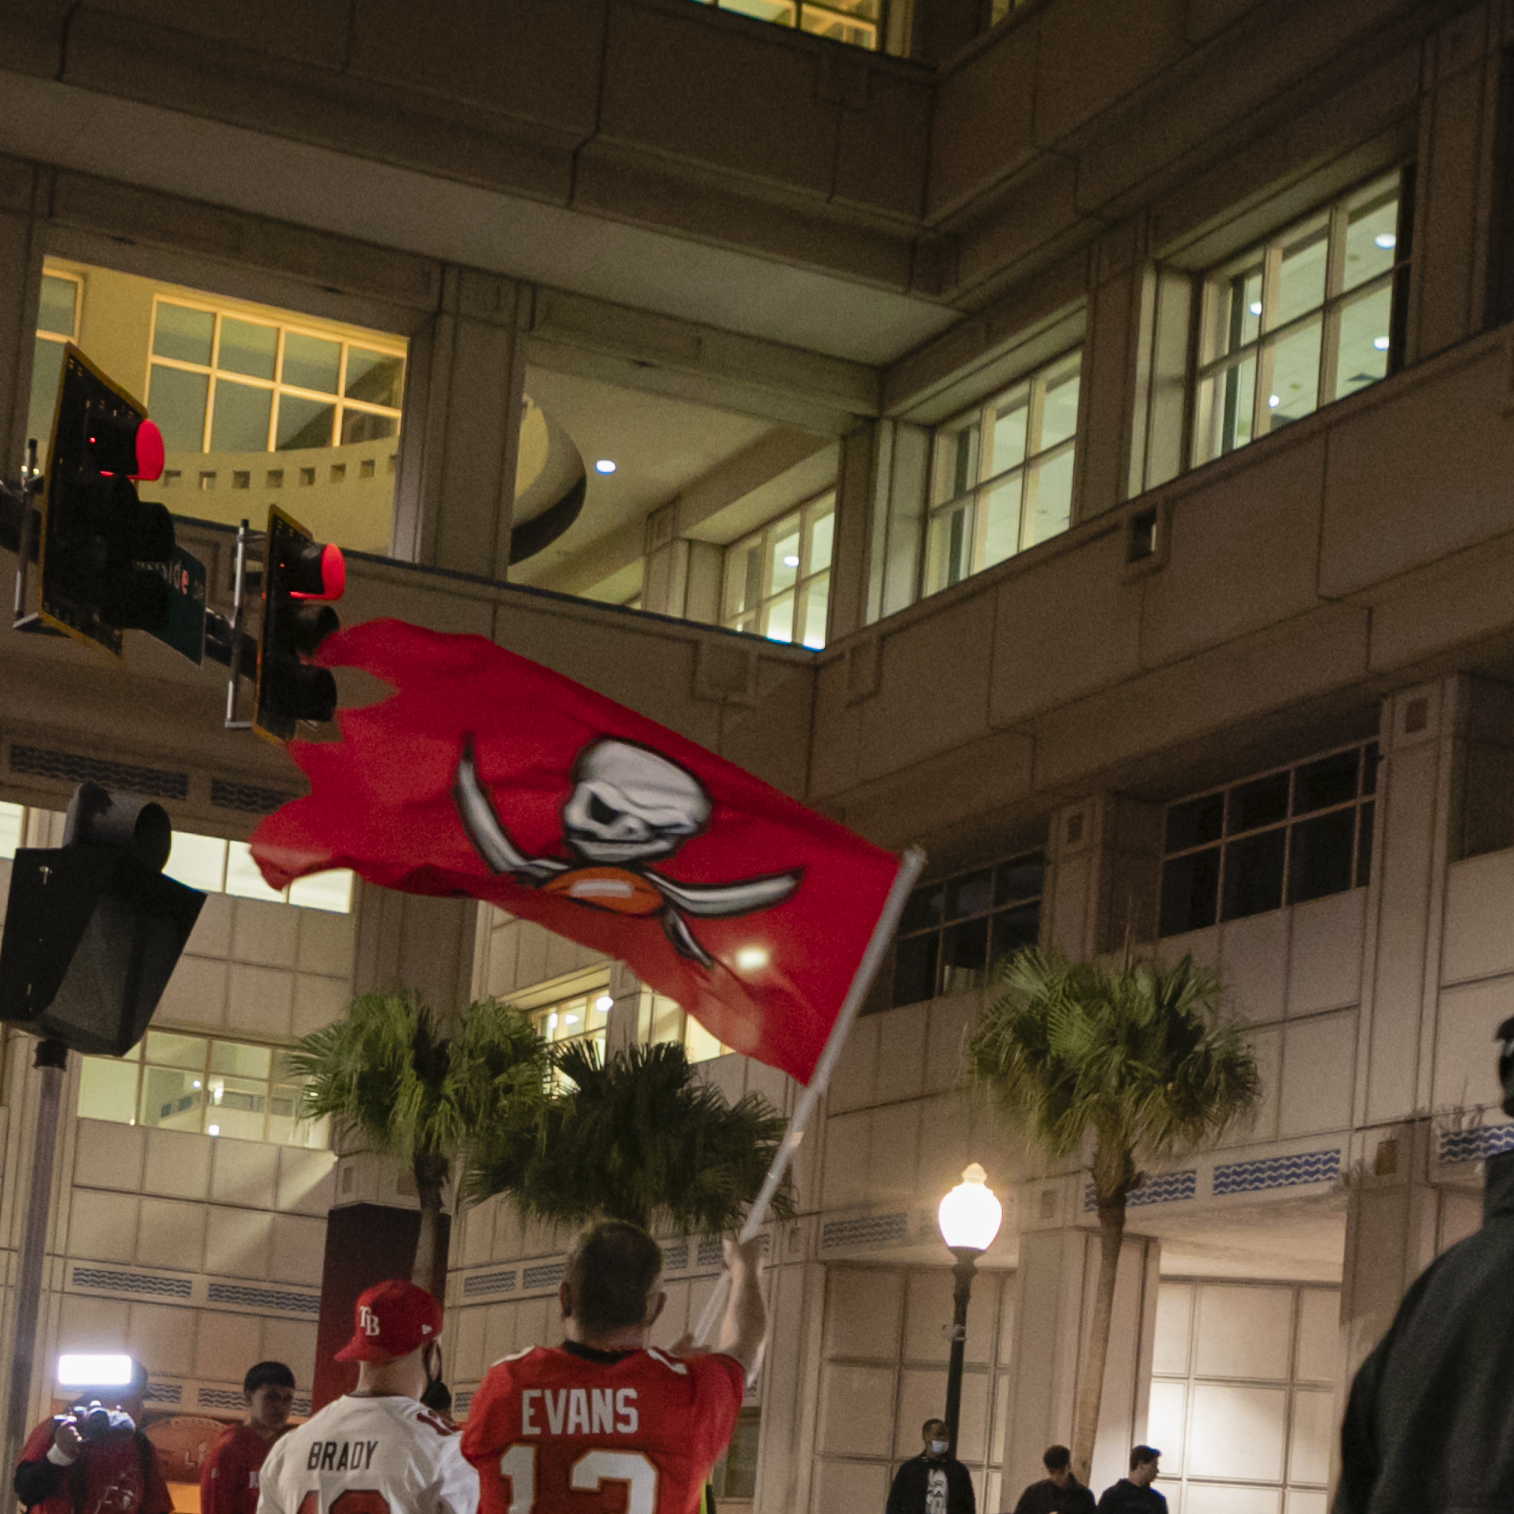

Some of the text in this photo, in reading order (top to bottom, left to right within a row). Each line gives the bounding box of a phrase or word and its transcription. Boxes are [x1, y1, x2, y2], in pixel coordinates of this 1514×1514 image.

[360, 1305, 381, 1336] TB
[521, 1387, 639, 1435] EVANS
[307, 1440, 378, 1471] BRADY
